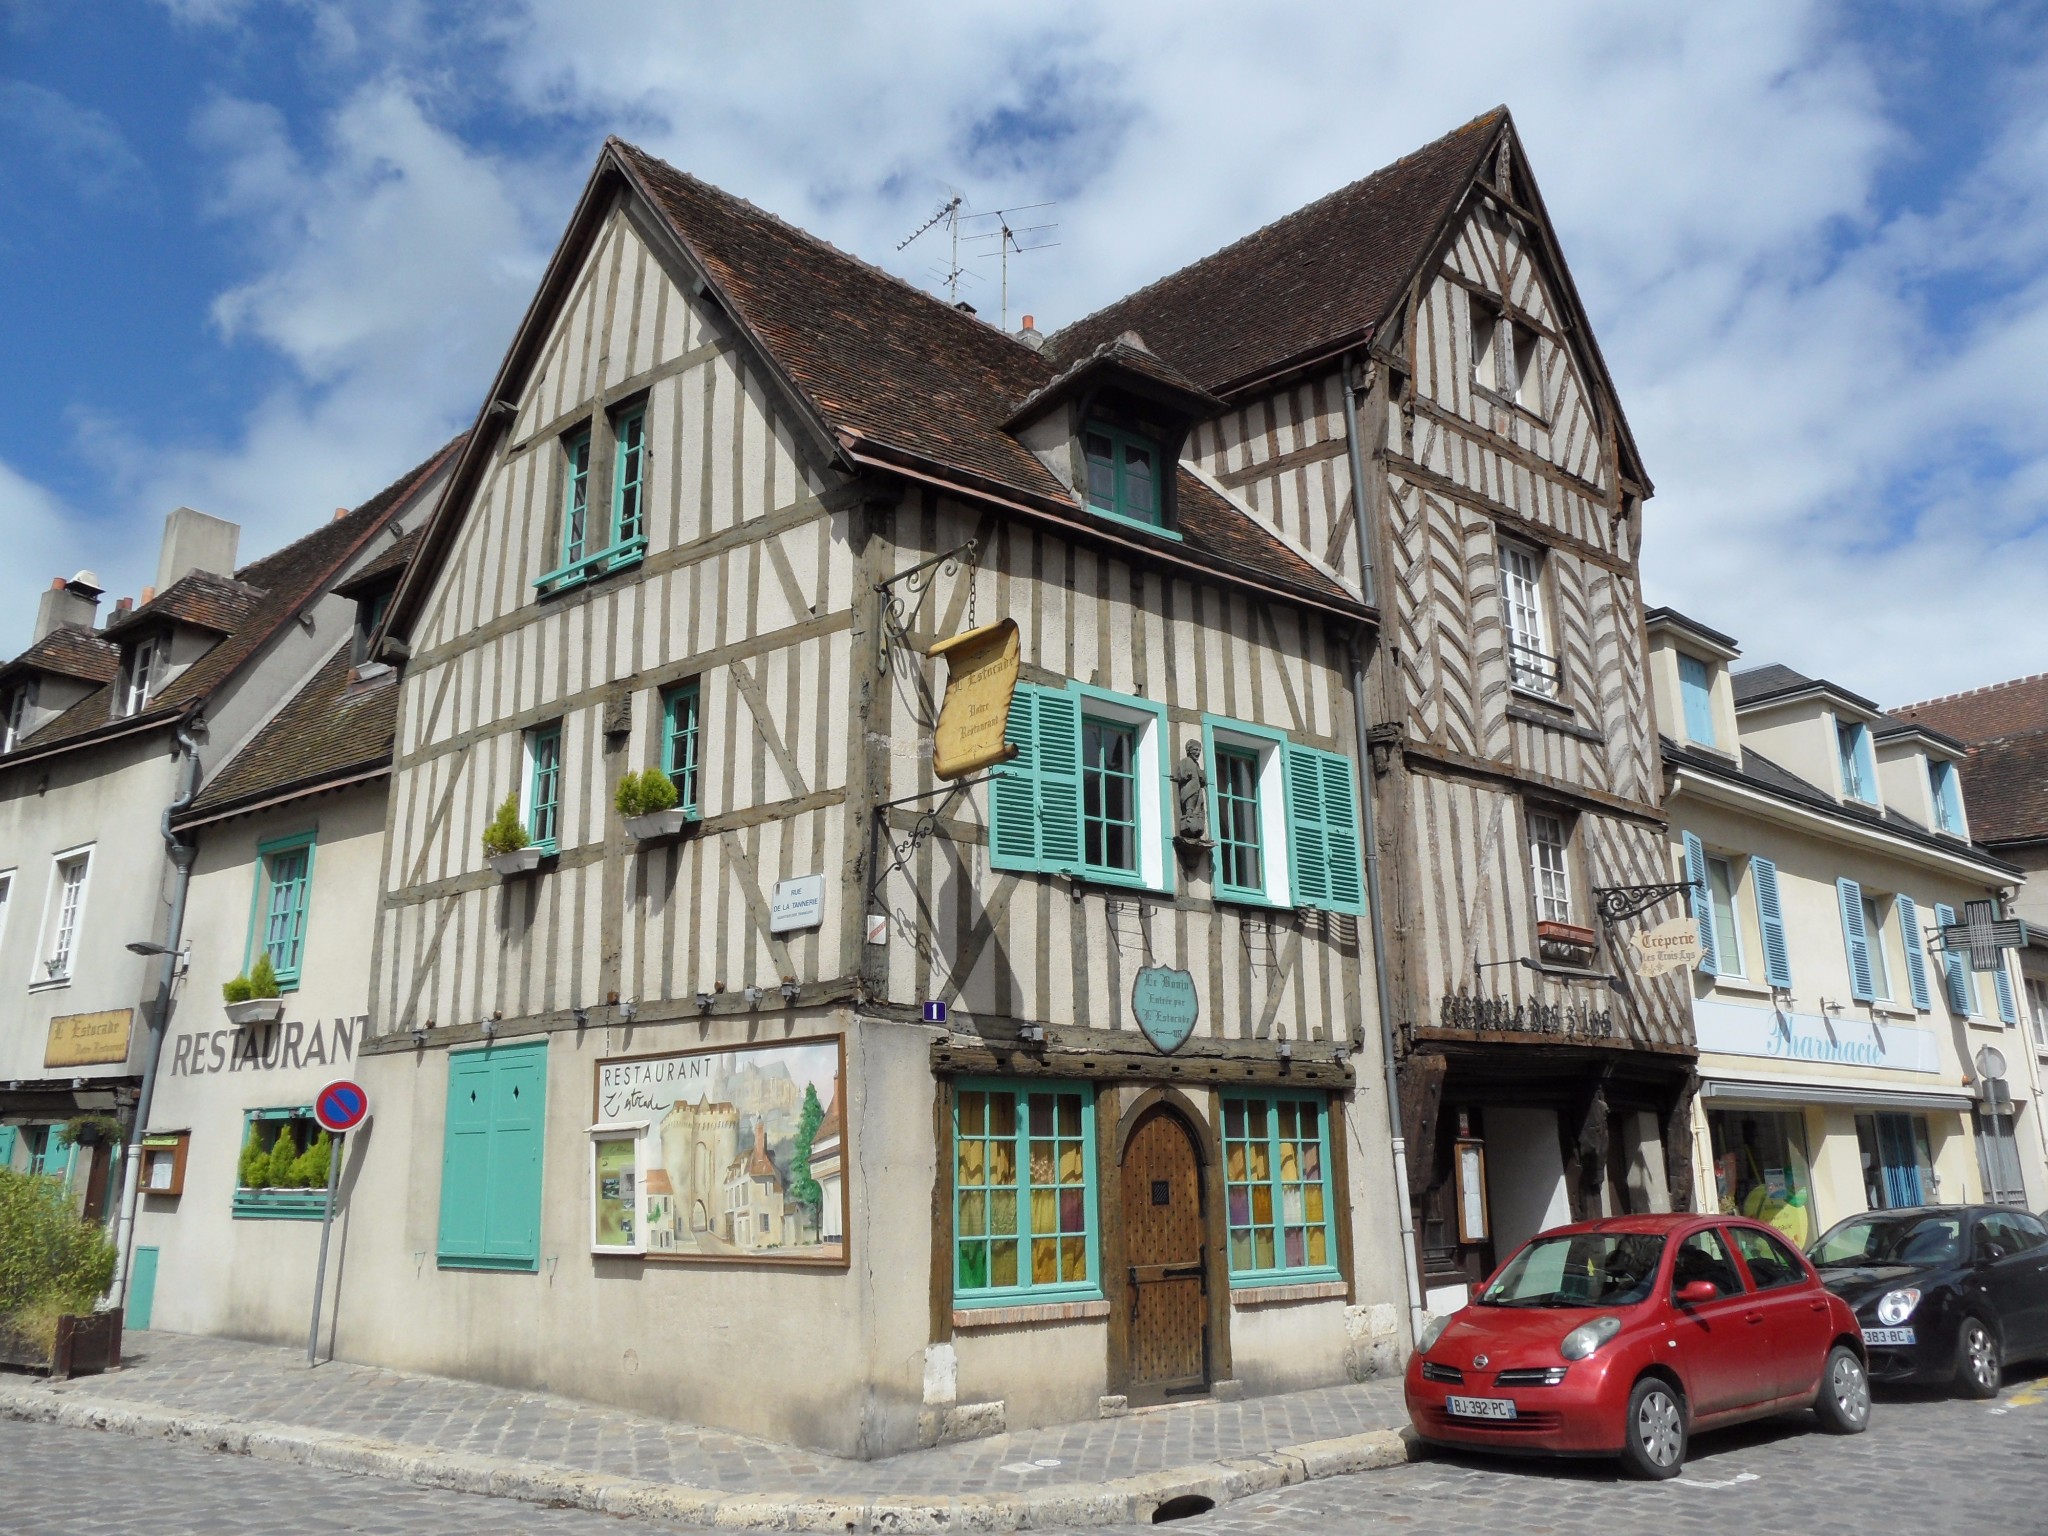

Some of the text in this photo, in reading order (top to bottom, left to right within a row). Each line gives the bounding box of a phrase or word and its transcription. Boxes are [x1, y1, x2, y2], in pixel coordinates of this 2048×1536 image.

[790, 887, 803, 897] RUE
[773, 897, 819, 912] DE LA TANNERIE
[1656, 950, 1678, 961] Trois
[1679, 950, 1696, 961] Lys
[931, 1003, 938, 1020] 1
[1174, 999, 1186, 1008] par
[1766, 1012, 1884, 1066] Pharmacie
[604, 1058, 711, 1087] RESTAURANT
[1454, 1399, 1507, 1416] BJ-392-PC
